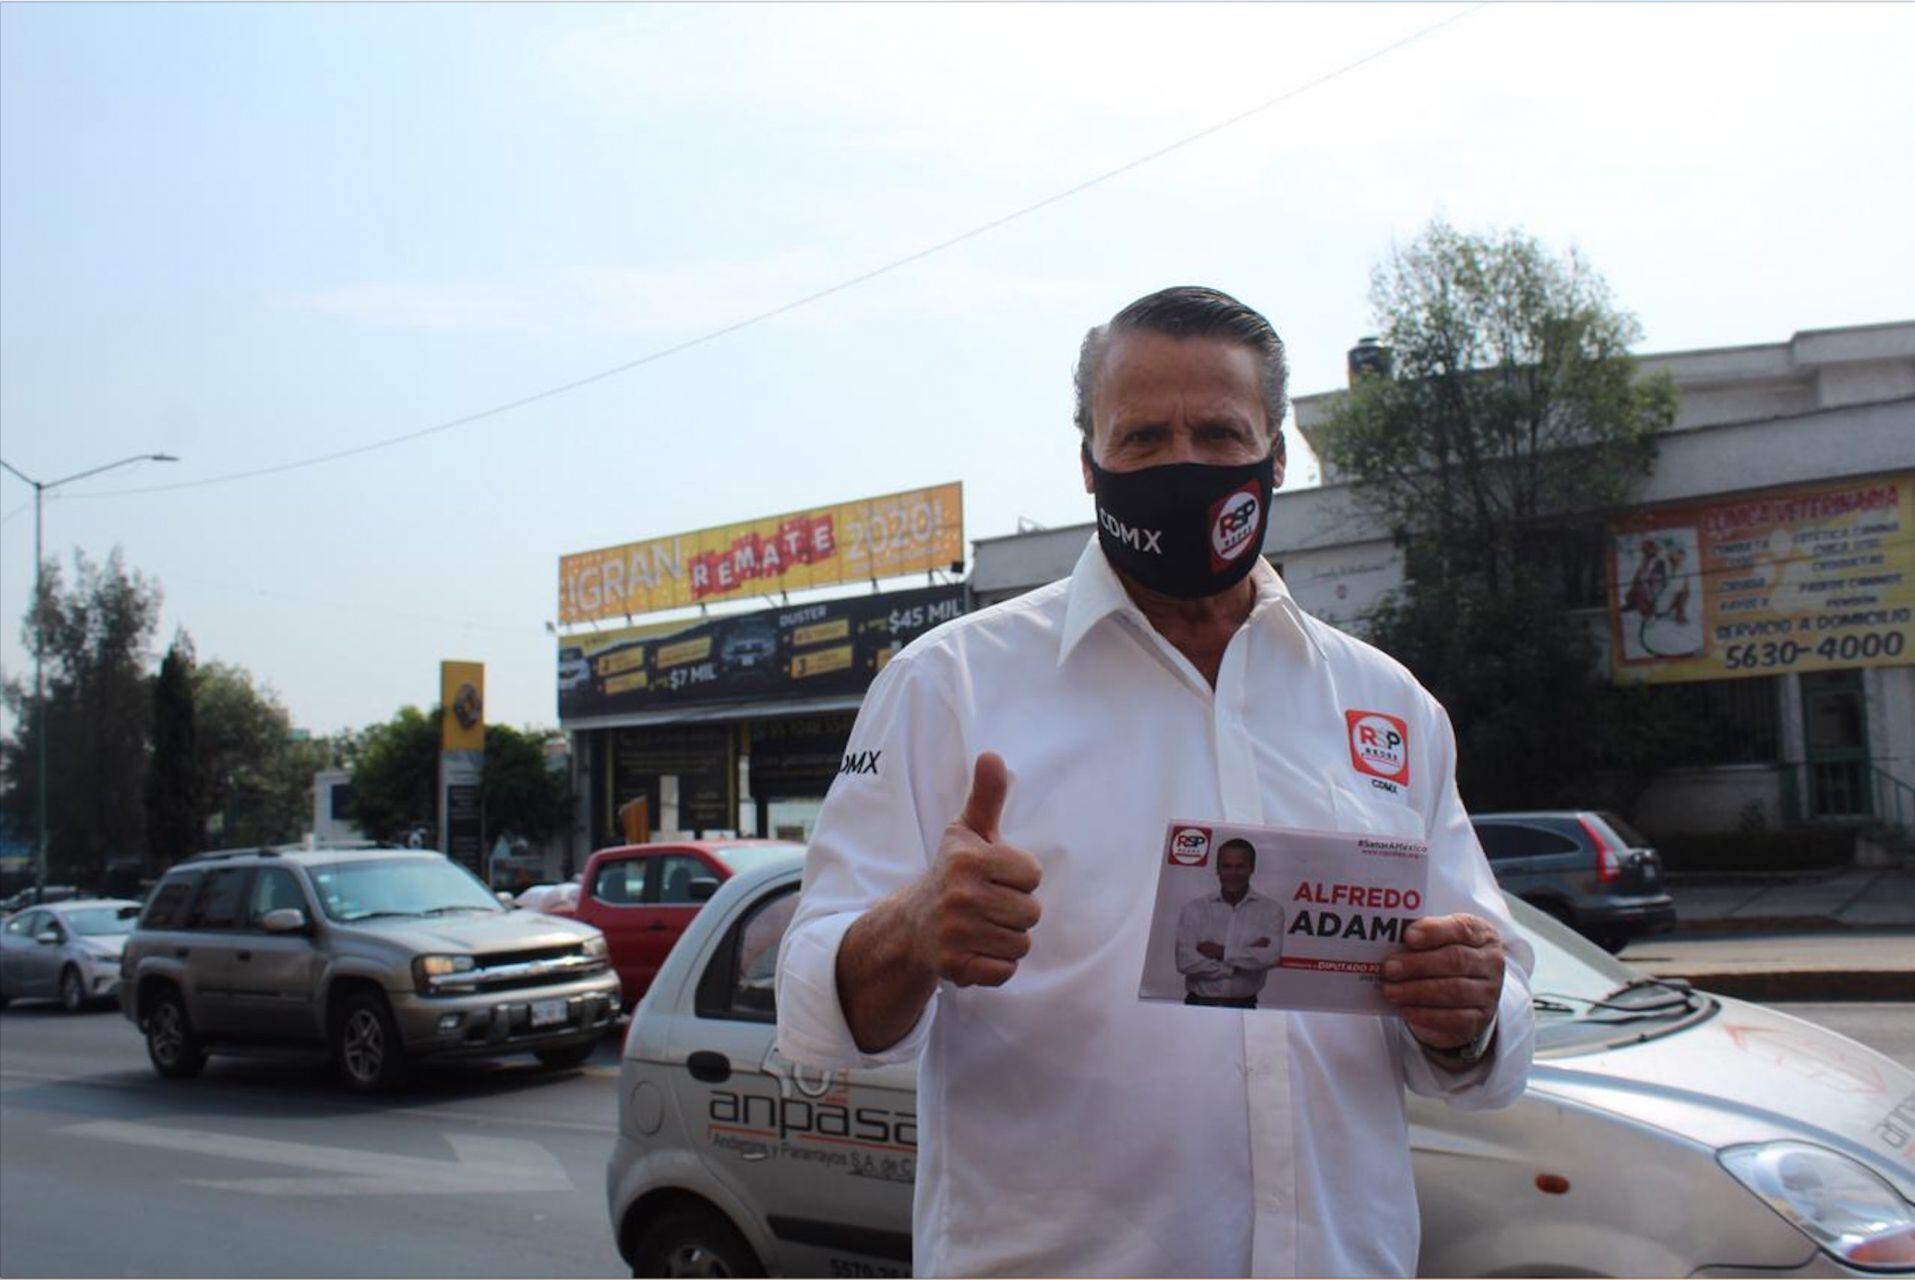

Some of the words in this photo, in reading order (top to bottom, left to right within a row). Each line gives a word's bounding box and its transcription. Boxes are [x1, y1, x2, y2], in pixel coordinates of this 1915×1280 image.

[1219, 499, 1256, 539] RSP
[692, 524, 831, 588] REMATE
[846, 498, 944, 560] 2020!
[889, 608, 924, 634] $45
[928, 599, 962, 622] MIL
[1726, 631, 1904, 669] 5630-4000
[1177, 835, 1205, 847] RSP
[1293, 881, 1422, 911] ALFREDO
